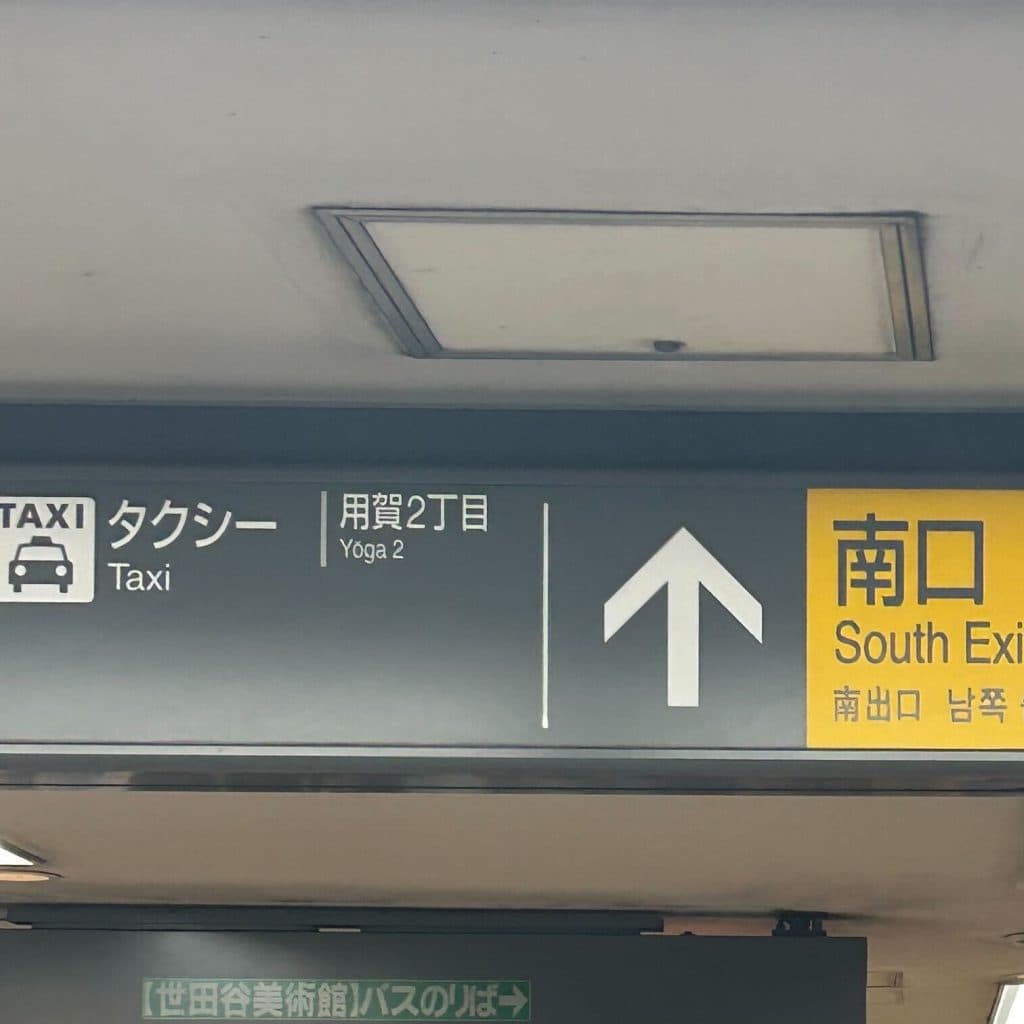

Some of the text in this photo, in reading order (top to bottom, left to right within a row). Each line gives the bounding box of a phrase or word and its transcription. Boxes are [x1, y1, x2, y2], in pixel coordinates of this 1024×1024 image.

[0, 503, 84, 528] TAXI
[108, 500, 277, 549] タクシー
[340, 493, 488, 532] 用賀2丁目
[393, 539, 404, 559] 2
[833, 512, 984, 606] 南口
[108, 563, 170, 591] Taxi
[835, 621, 949, 664] South
[833, 686, 921, 723] 南出口
[948, 687, 1007, 723] 남쪽
